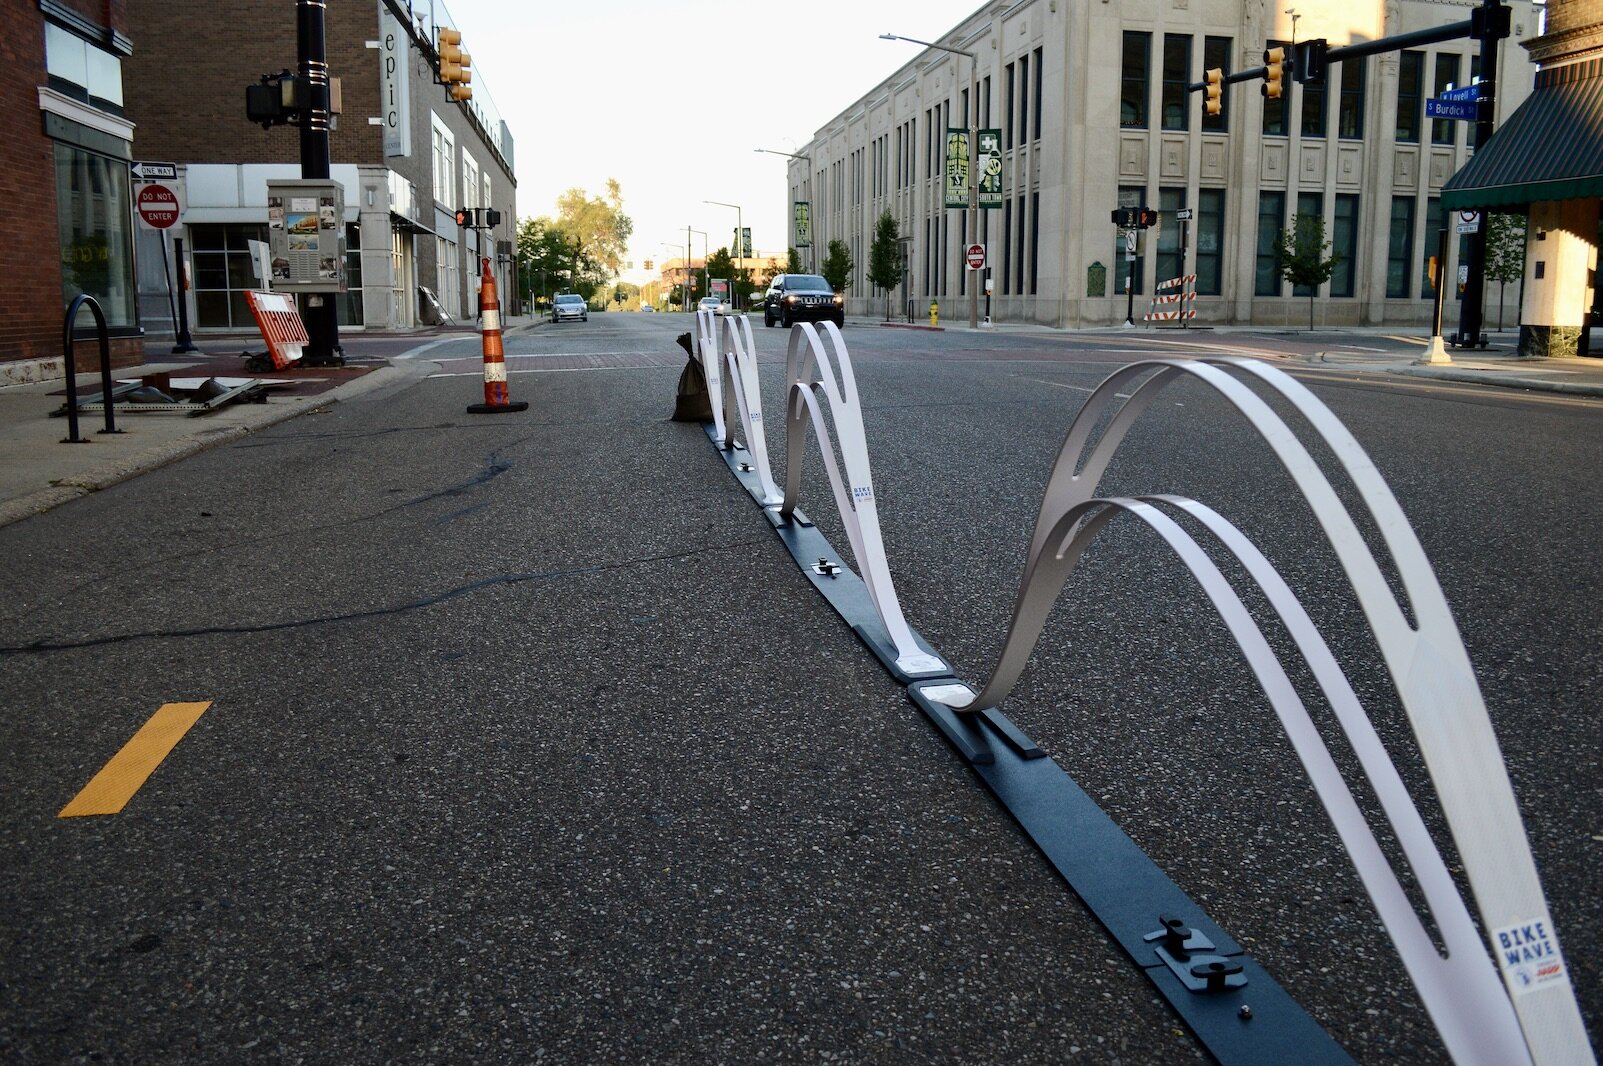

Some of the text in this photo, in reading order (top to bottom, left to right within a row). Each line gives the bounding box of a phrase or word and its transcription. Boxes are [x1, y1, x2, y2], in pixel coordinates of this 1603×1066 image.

[385, 33, 397, 128] epic
[1449, 90, 1469, 100] Lovell
[1428, 102, 1475, 116] S Burdick St
[141, 167, 156, 175] ONE
[142, 192, 172, 201] DO NOT
[1498, 922, 1547, 949] BIKE
[1504, 941, 1554, 965] WAVE
